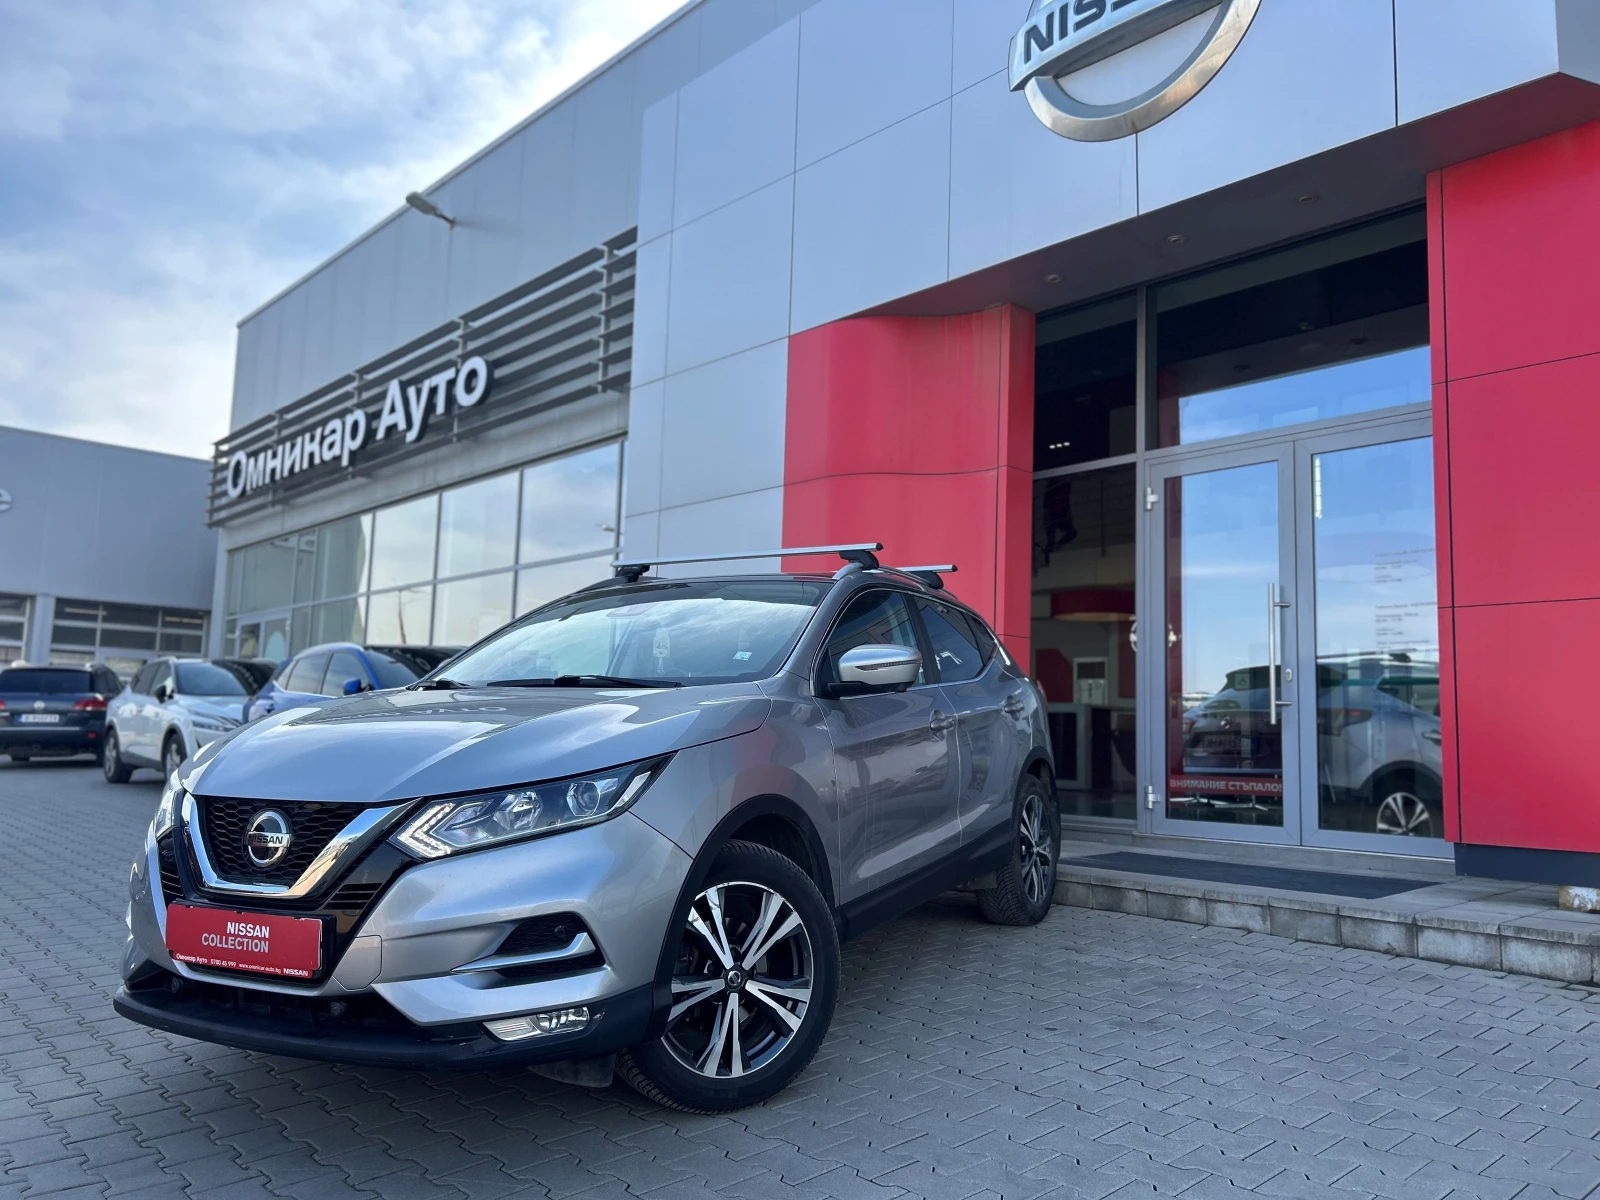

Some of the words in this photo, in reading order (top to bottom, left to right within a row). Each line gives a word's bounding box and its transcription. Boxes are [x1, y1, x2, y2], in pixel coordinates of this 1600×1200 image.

[226, 409, 367, 499] Омникар
[376, 356, 488, 443] Ауто
[1169, 779, 1227, 790] ВНИМАНИЕ
[249, 832, 284, 845] NISSAN
[227, 922, 269, 938] NISSAN
[202, 933, 269, 953] COLLECTION
[283, 967, 309, 977] NISSAN
